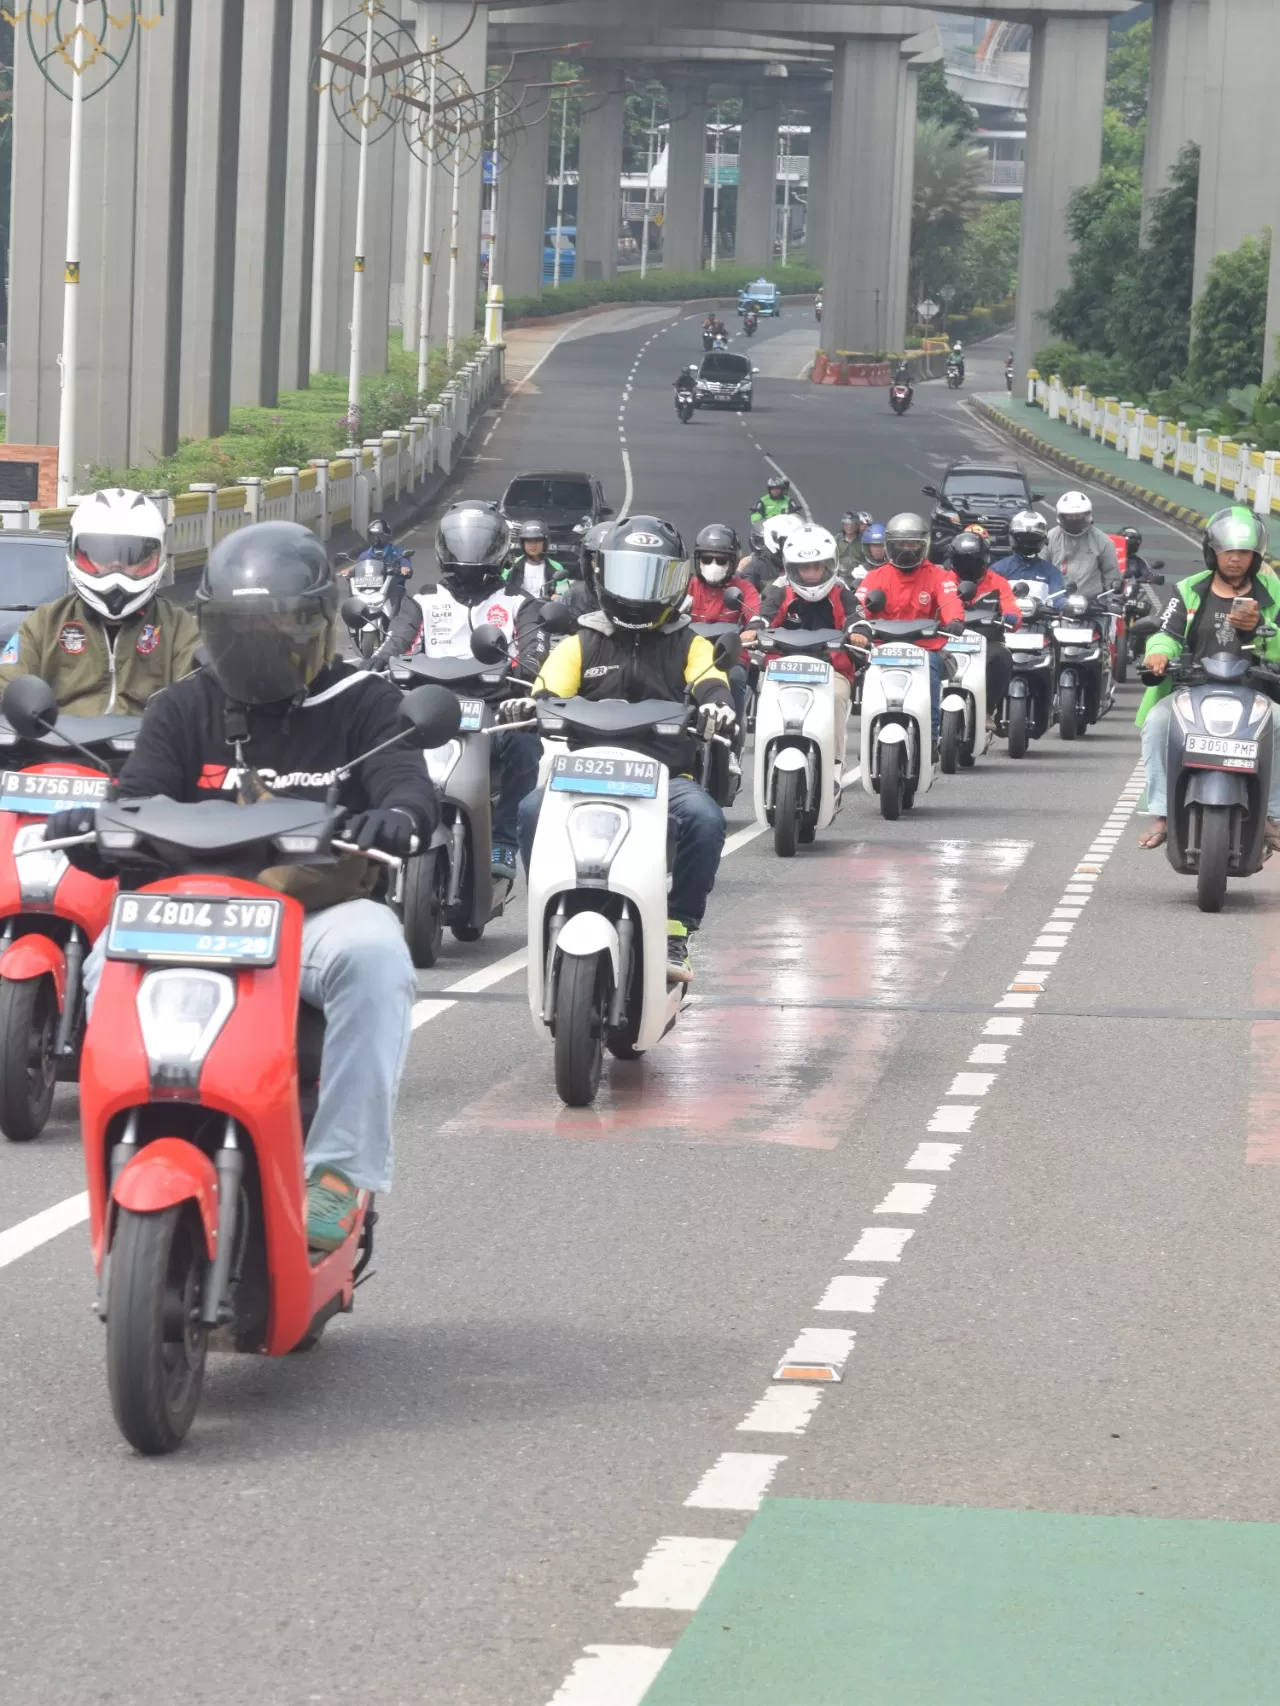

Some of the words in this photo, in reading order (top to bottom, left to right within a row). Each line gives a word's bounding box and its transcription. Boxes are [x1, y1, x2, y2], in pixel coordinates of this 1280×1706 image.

[781, 662, 803, 672] 6921
[1189, 738, 1196, 750] B
[1200, 739, 1228, 753] 3050
[1234, 743, 1256, 757] PMF
[557, 757, 567, 771] B
[574, 758, 615, 775] 6925
[7, 775, 19, 792] B
[24, 776, 70, 795] 5756
[72, 780, 107, 797] BWE
[122, 900, 138, 923] B
[146, 900, 213, 927] 4804
[223, 904, 273, 928] SVB
